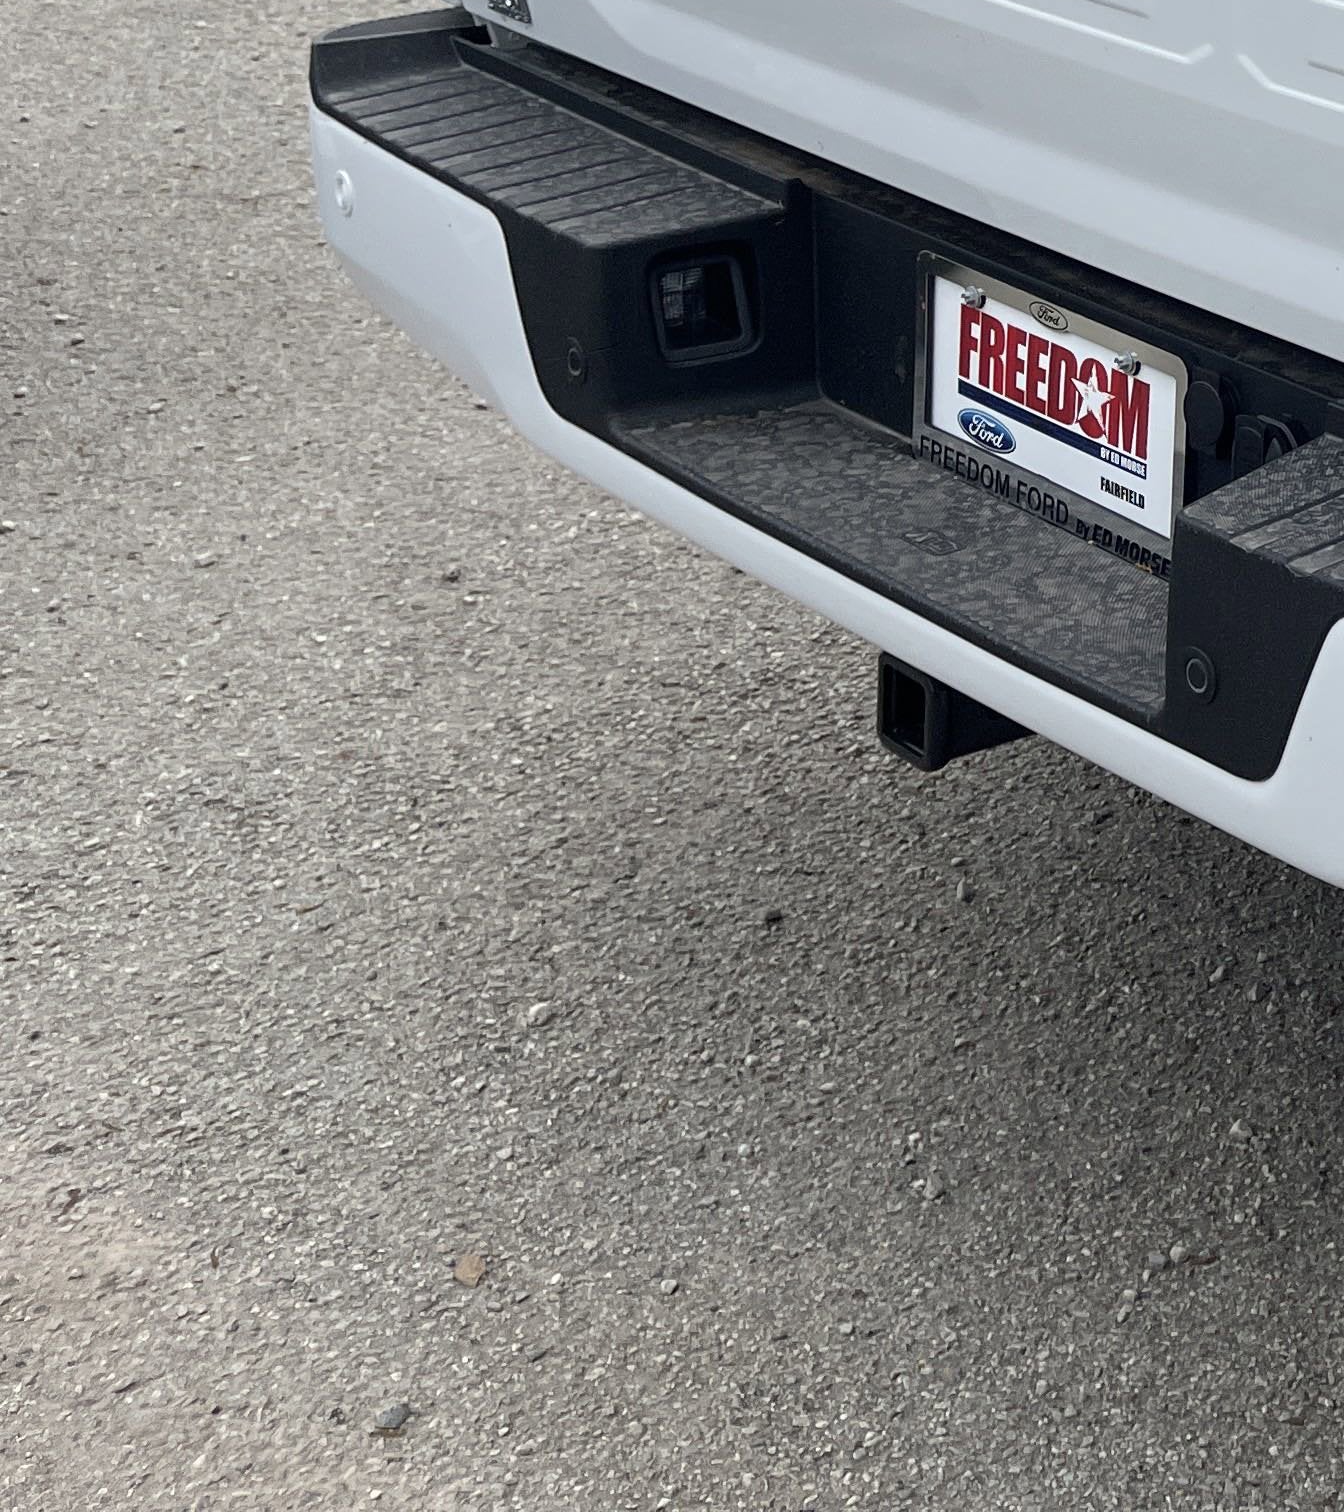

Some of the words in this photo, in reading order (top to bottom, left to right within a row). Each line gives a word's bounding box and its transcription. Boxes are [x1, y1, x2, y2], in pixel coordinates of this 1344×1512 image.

[958, 303, 1151, 460] FREEDOM
[967, 414, 1005, 449] Ford
[1100, 446, 1110, 461] BY
[1110, 451, 1120, 465] ED
[1120, 455, 1146, 477] MORSE
[919, 436, 1011, 497] FREEDOM
[1016, 483, 1070, 526] FORD
[1092, 524, 1113, 547] ED
[1114, 535, 1171, 577] MORSE
[1100, 475, 1145, 510] FAIRFIELD
